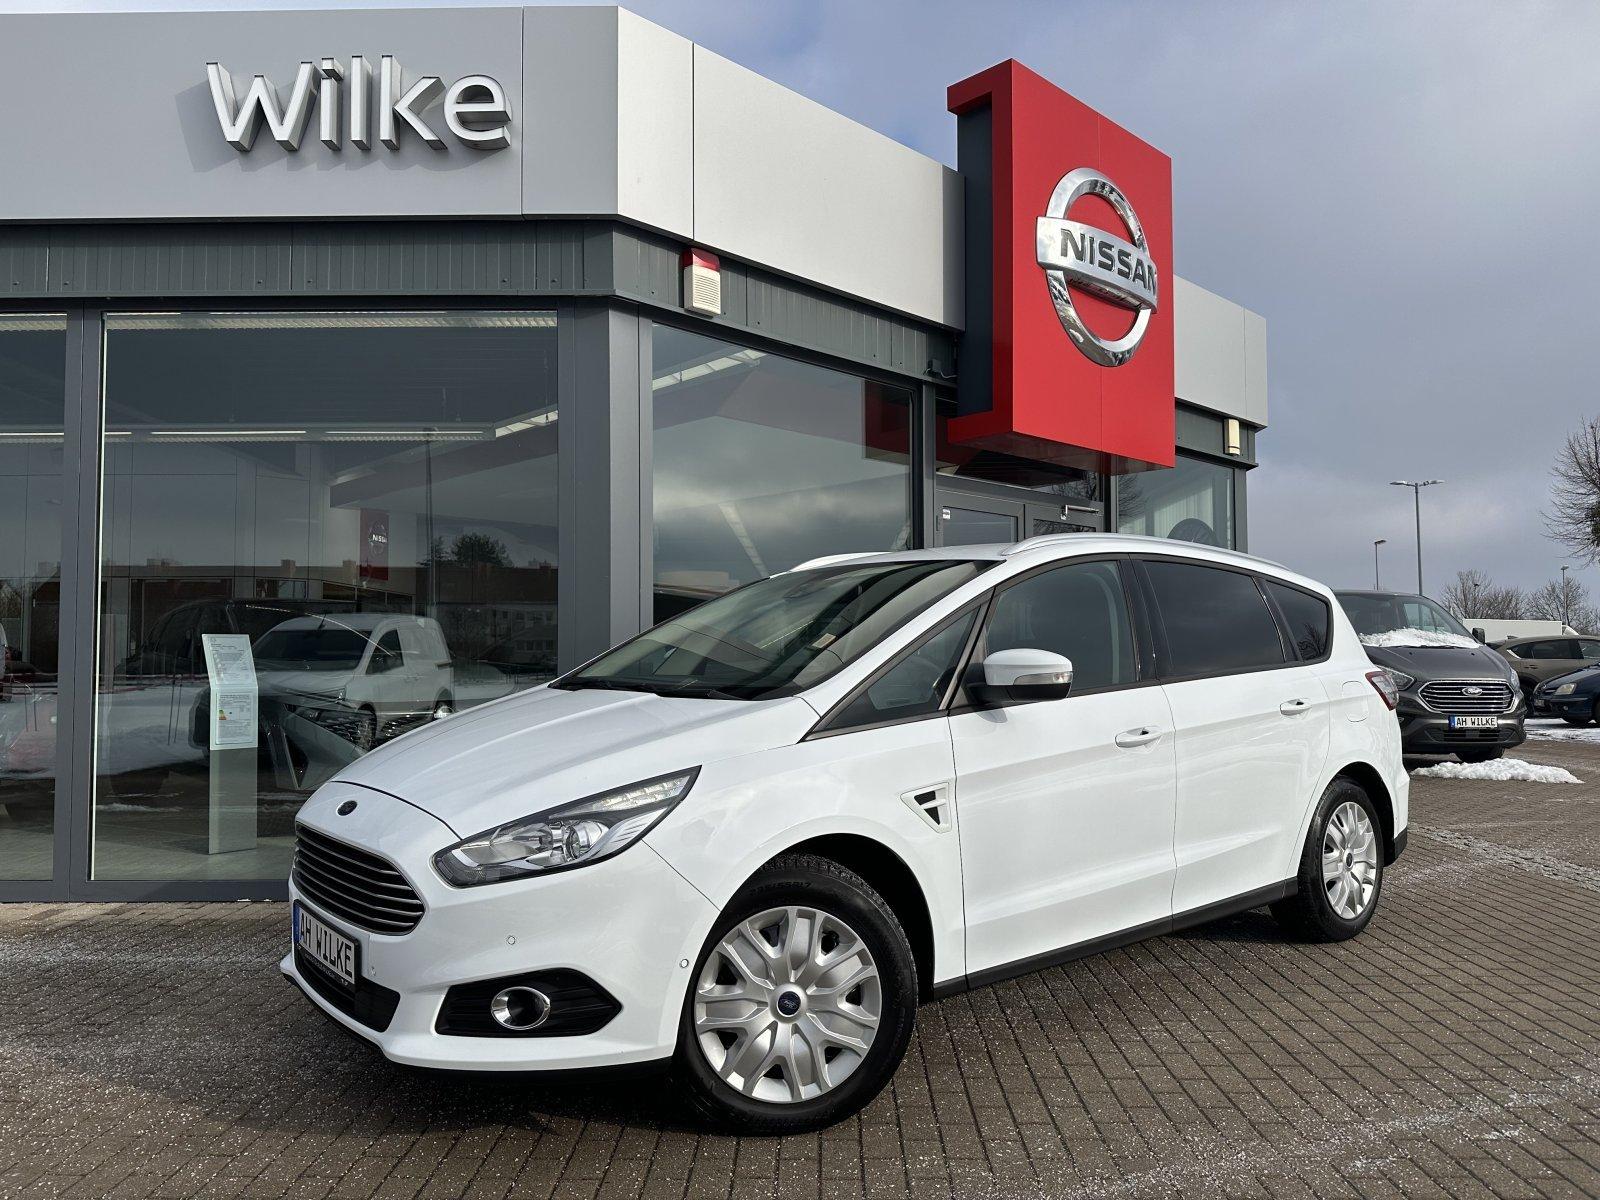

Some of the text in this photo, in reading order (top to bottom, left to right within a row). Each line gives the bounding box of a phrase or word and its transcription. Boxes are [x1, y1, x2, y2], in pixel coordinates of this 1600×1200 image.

[206, 54, 512, 151] Wilke
[1060, 228, 1157, 296] NISSAN
[1456, 717, 1496, 726] AH WILKE
[300, 912, 312, 949] AH
[315, 923, 353, 979] WILKE
